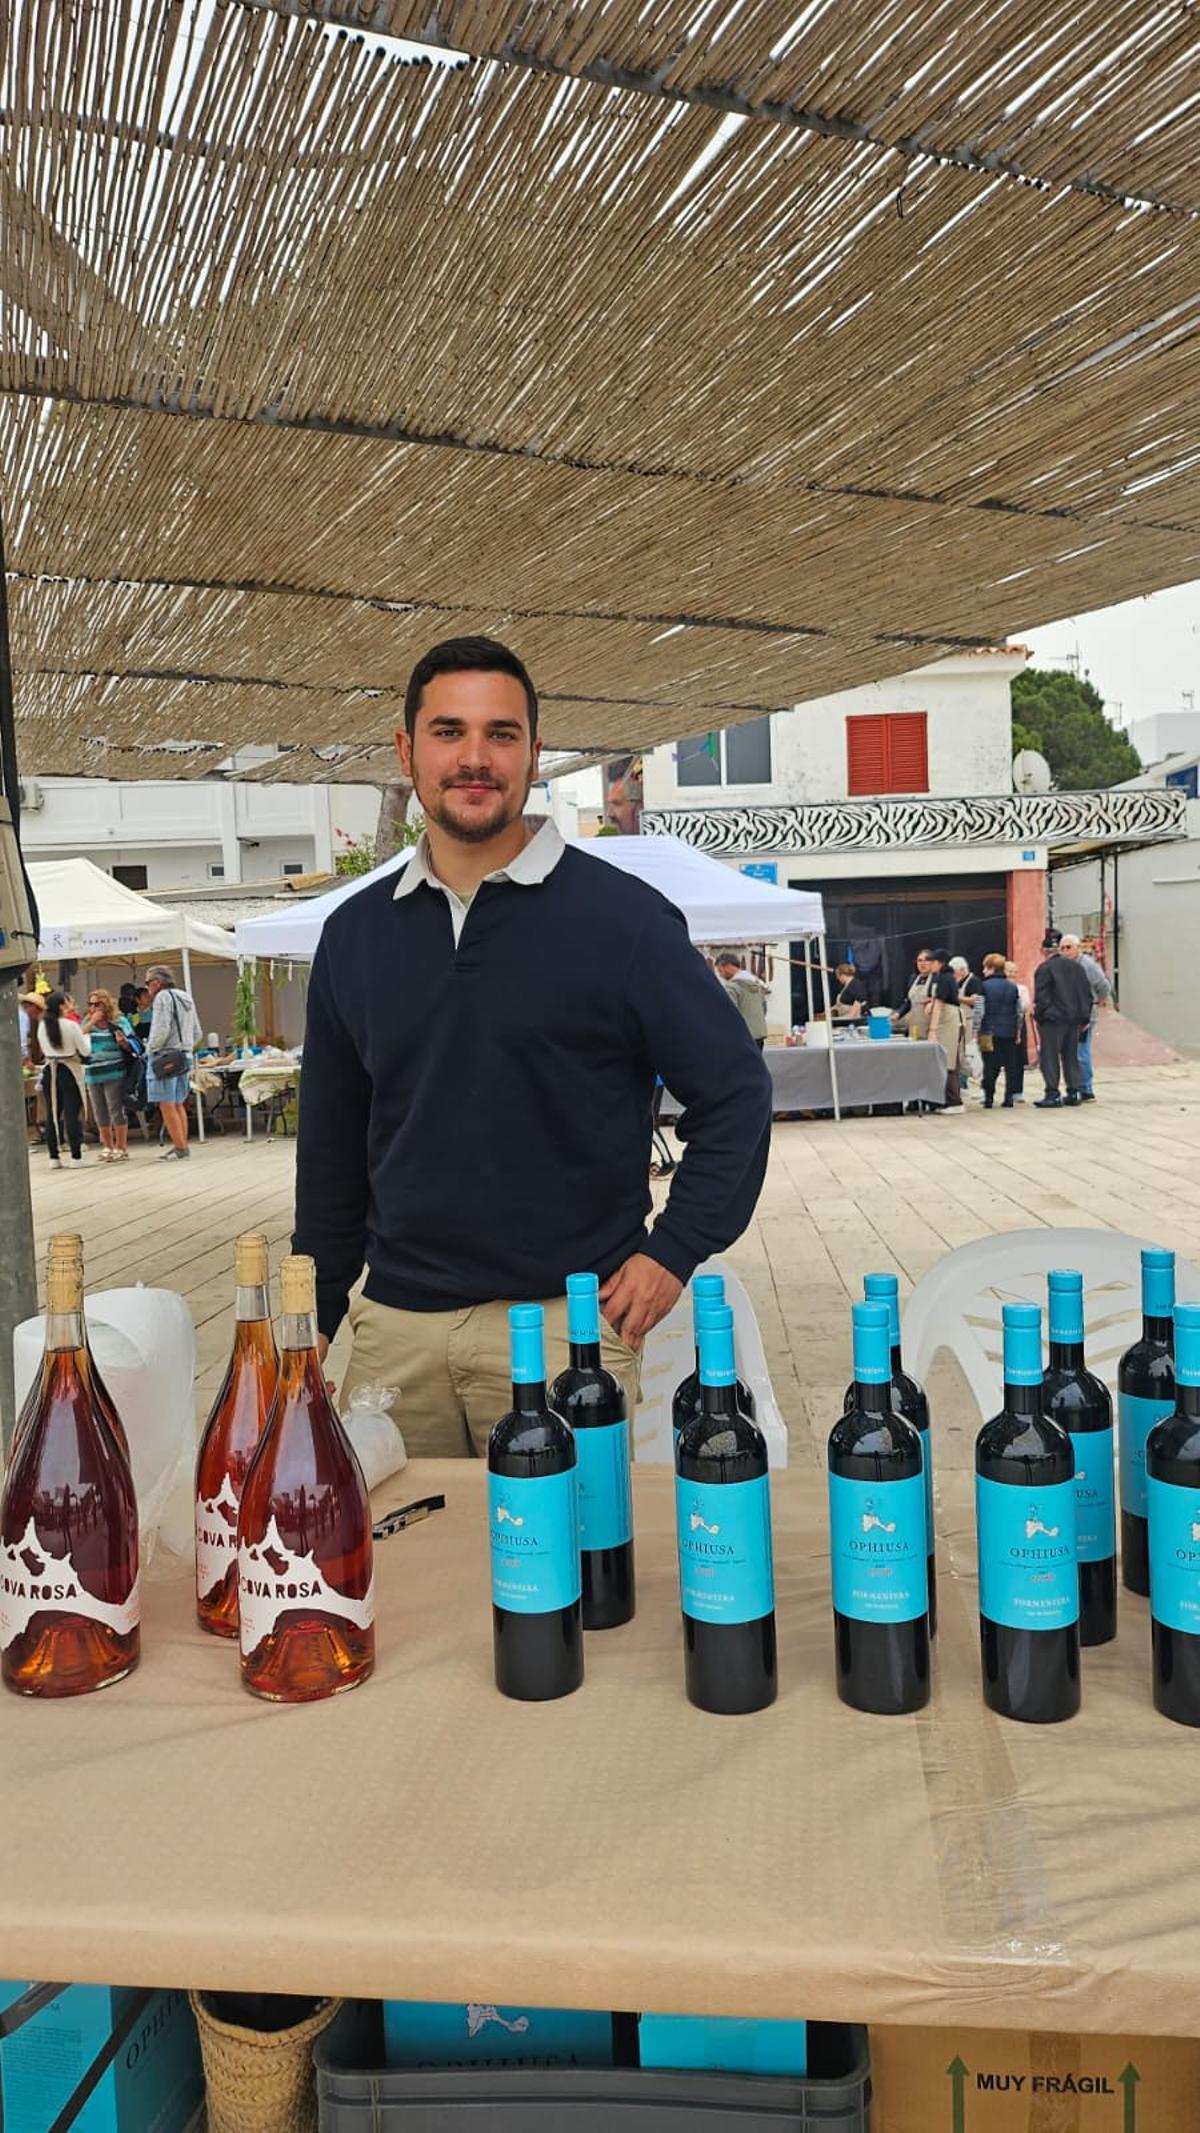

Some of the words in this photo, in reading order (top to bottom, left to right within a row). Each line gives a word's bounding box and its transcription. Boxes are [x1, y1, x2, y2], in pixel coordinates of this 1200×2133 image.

[849, 1540, 911, 1553] OPHIUSA
[1009, 1545, 1070, 1559] OPHIUSA
[30, 1583, 77, 1600] ROSA
[275, 1580, 322, 1599] ROSA
[976, 2073, 1026, 2091] MUY
[1032, 2073, 1115, 2094] FRÁGIL
